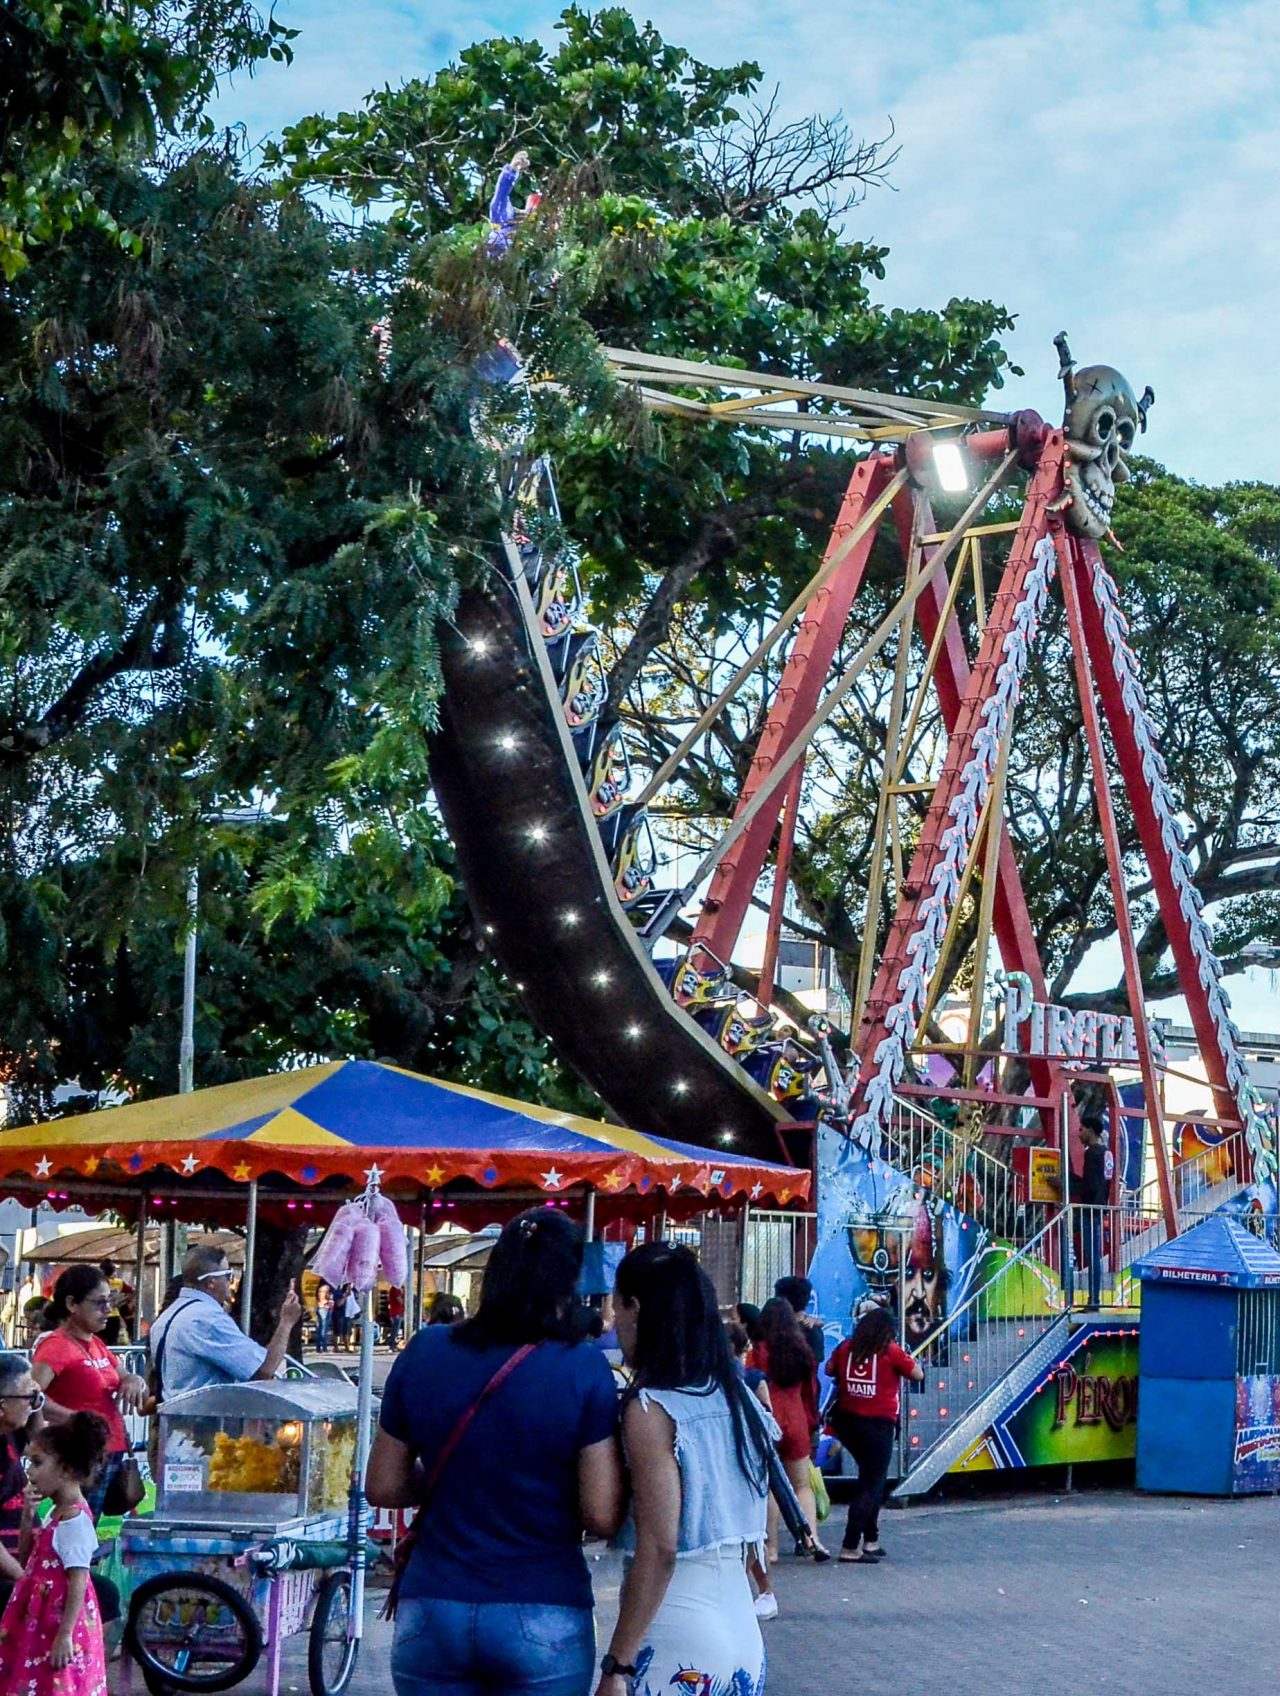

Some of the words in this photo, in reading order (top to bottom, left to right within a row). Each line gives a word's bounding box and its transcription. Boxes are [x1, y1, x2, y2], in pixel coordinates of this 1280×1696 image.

[1162, 1269, 1217, 1282] BILHETERIA
[846, 1382, 876, 1396] MAIN
[1050, 1352, 1138, 1426] PÉRO
